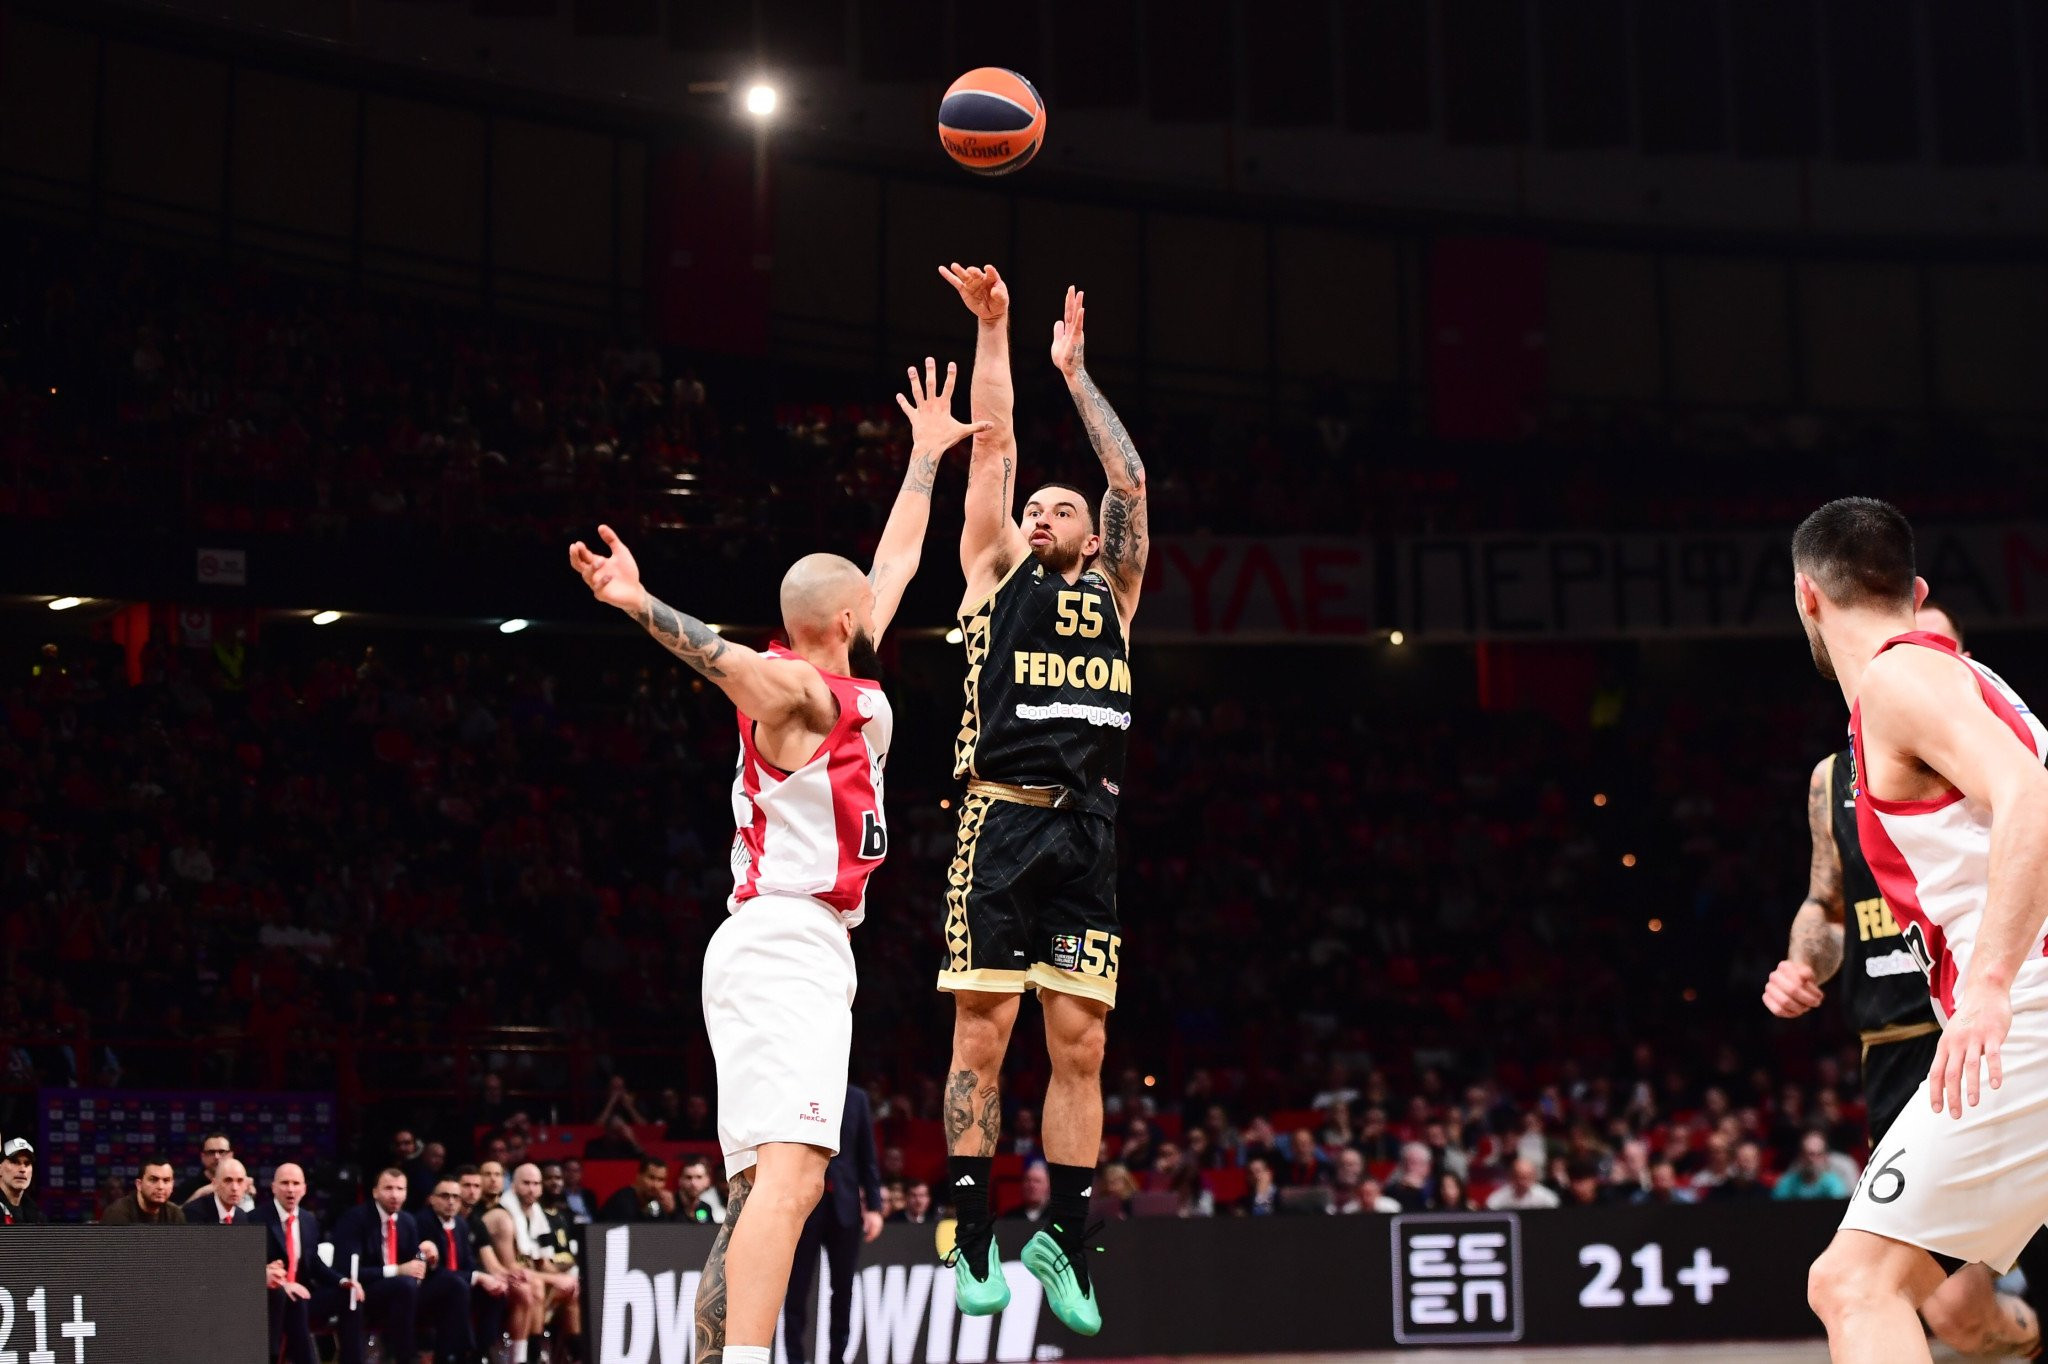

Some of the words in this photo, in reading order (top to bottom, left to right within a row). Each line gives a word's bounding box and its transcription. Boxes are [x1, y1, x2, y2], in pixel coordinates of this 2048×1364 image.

[1055, 590, 1104, 639] 55
[1014, 650, 1132, 696] FEDCOM
[1080, 928, 1122, 981] 55
[799, 1113, 828, 1124] FlexCar
[1578, 1241, 1731, 1308] 21+
